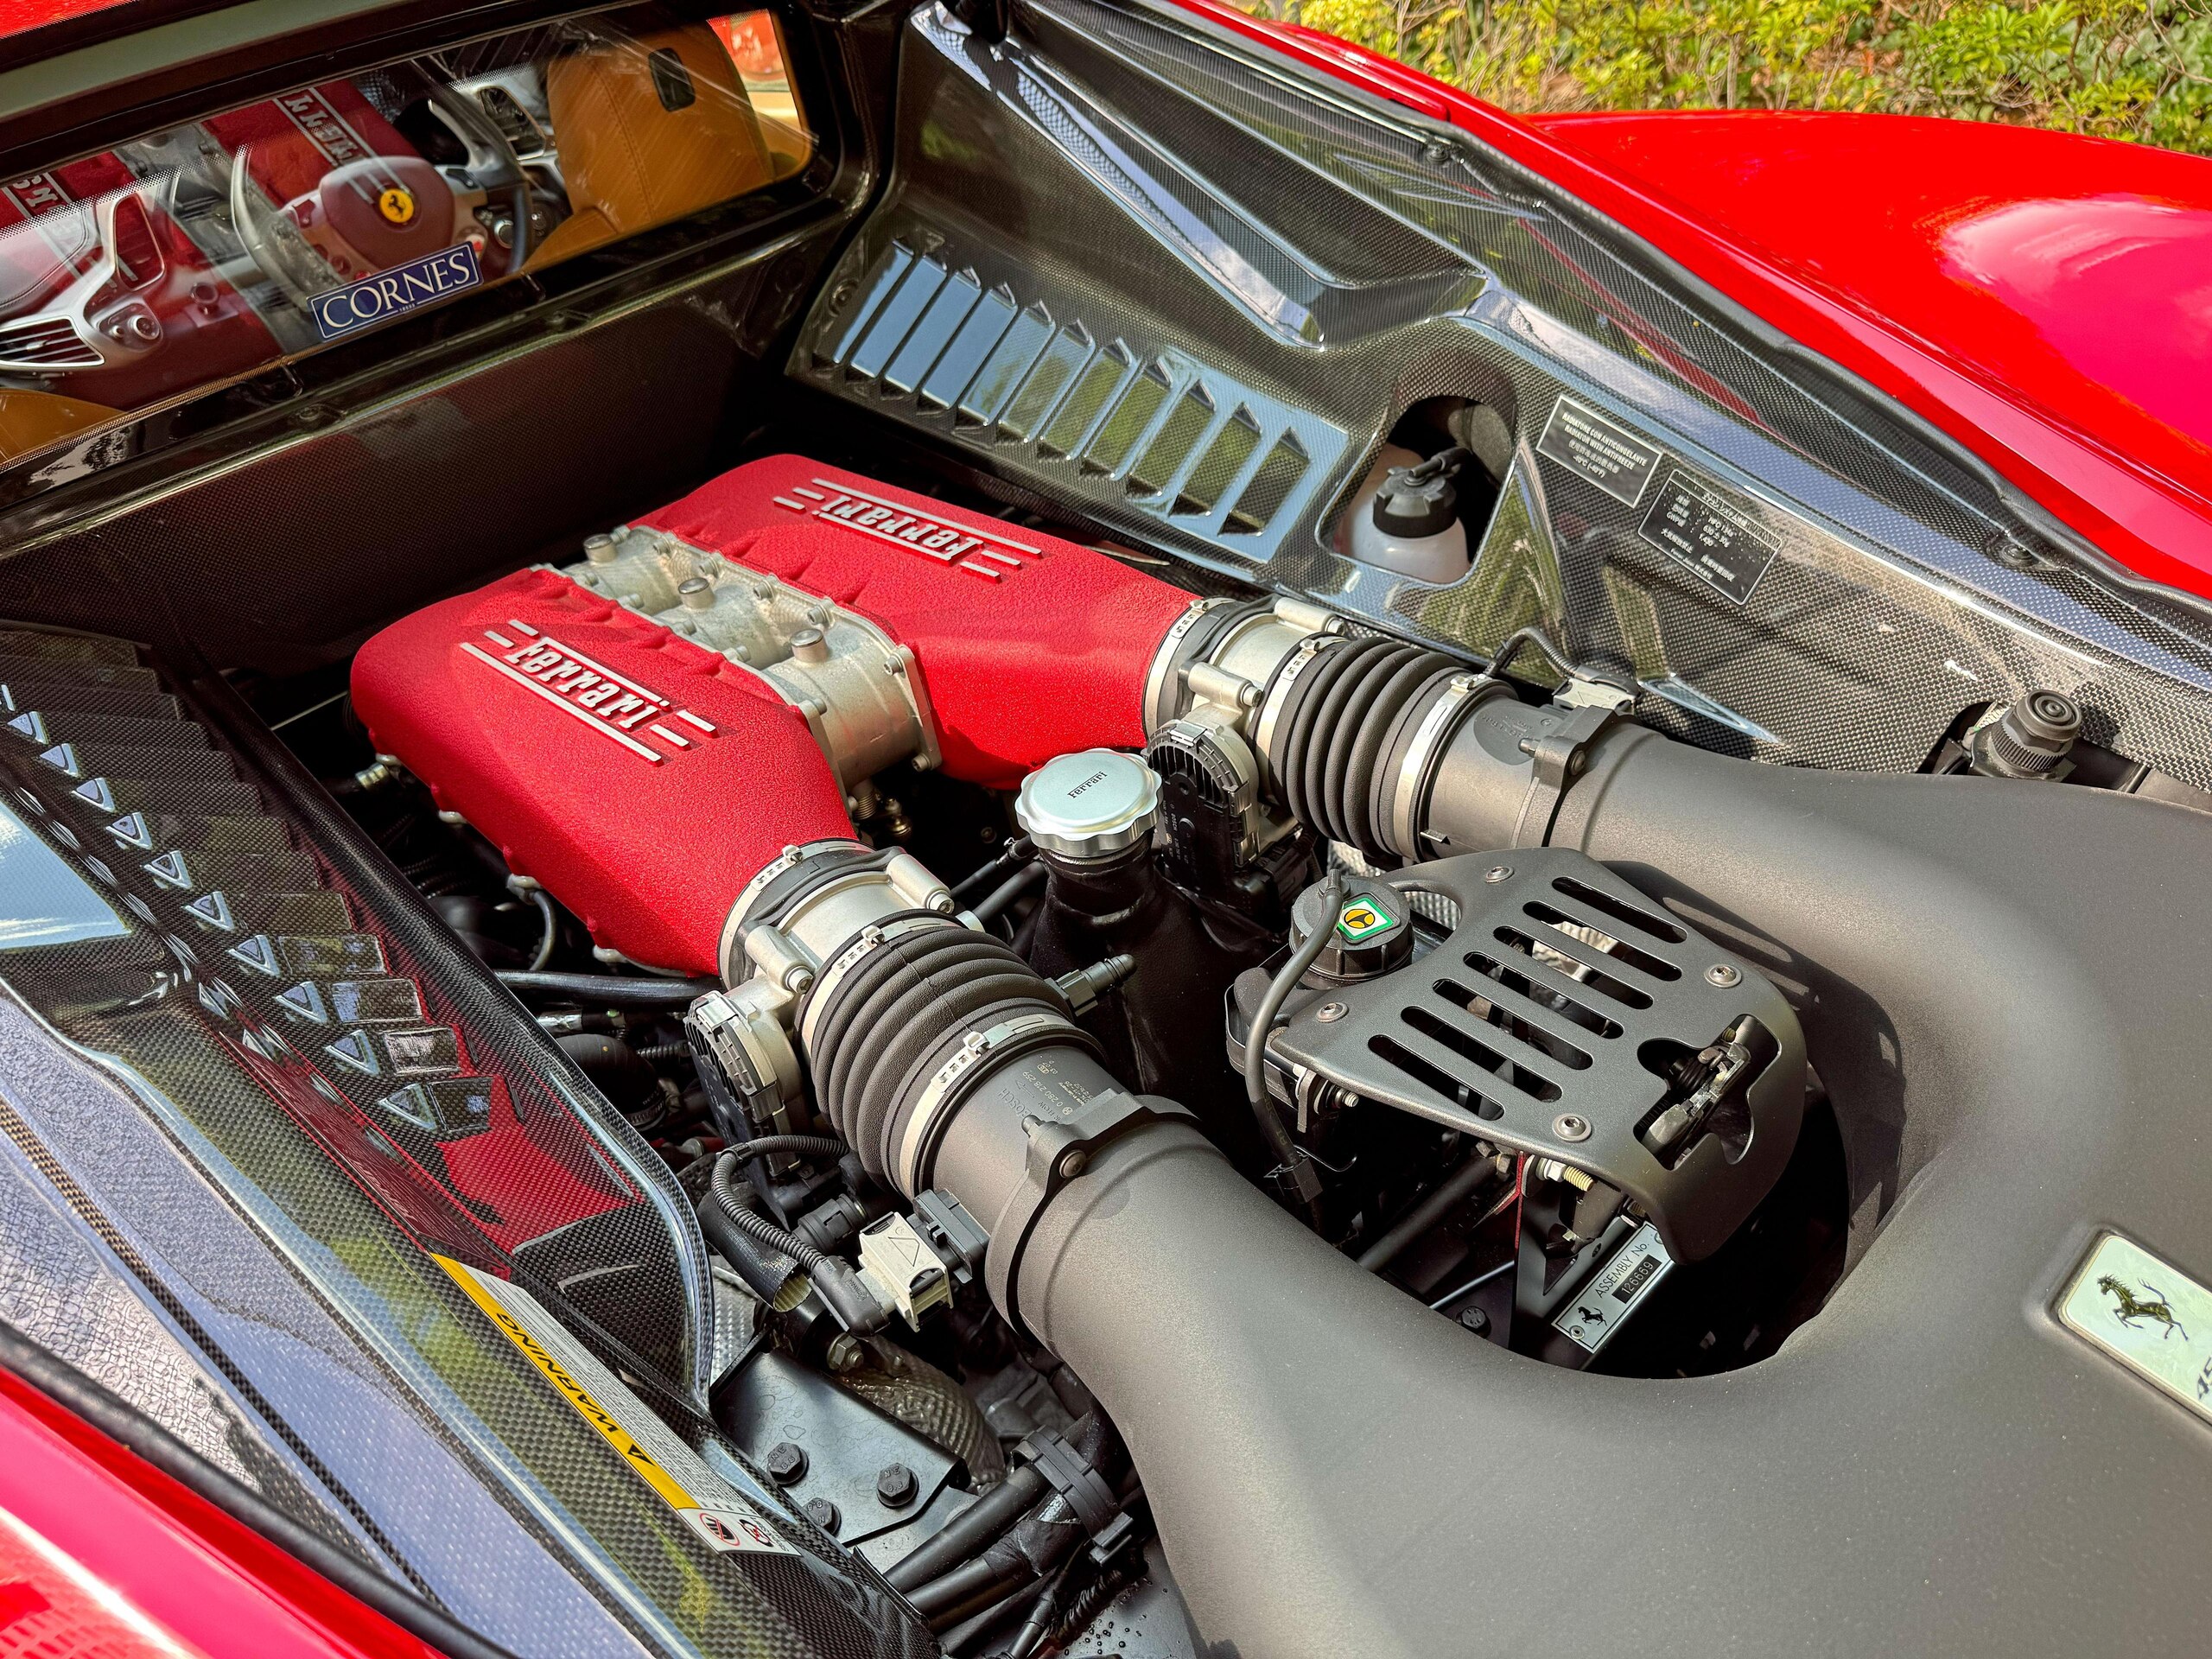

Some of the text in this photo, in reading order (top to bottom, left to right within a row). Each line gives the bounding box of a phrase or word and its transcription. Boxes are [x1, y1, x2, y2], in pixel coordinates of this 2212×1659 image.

[322, 251, 471, 330] CORNES
[1560, 411, 1592, 434] RADIATORE
[1588, 428, 1603, 441] CON
[1564, 424, 1592, 444] RADIATOR
[1589, 442, 1605, 453] WITH
[1601, 447, 1636, 470] ANTIFREEZE
[812, 495, 984, 562] Ferrari
[505, 637, 671, 729] Ferrari
[1067, 771, 1108, 799] Ferrari
[1022, 1071, 1036, 1082] 259
[1034, 1081, 1047, 1092] 218
[998, 1088, 1032, 1118] BOSCH
[1044, 1090, 1059, 1103] 280
[1595, 1242, 1649, 1298] ASSEMBLY No.
[1620, 1261, 1654, 1295] 126669
[496, 1312, 618, 1433] WARNING
